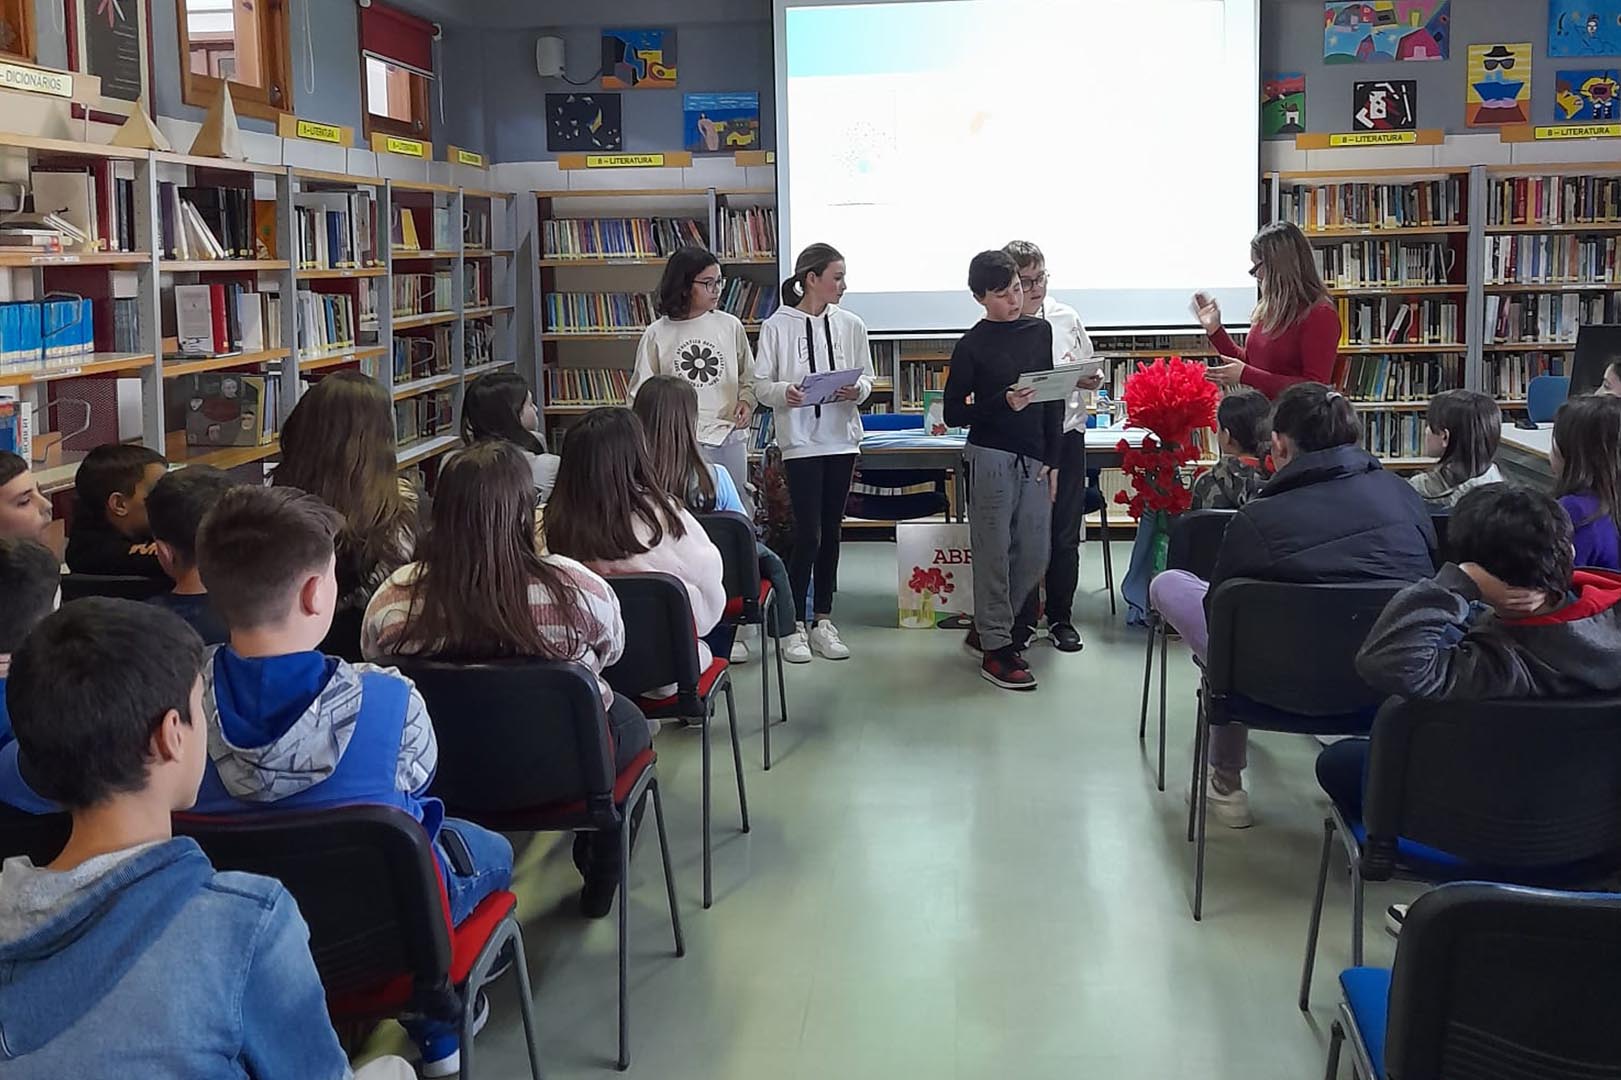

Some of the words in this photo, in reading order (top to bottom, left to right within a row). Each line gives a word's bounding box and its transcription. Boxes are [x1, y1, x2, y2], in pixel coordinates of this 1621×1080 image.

[1561, 127, 1610, 136] LITERATURA
[1355, 134, 1403, 143] LITERATURA
[610, 157, 653, 165] LITERATURA
